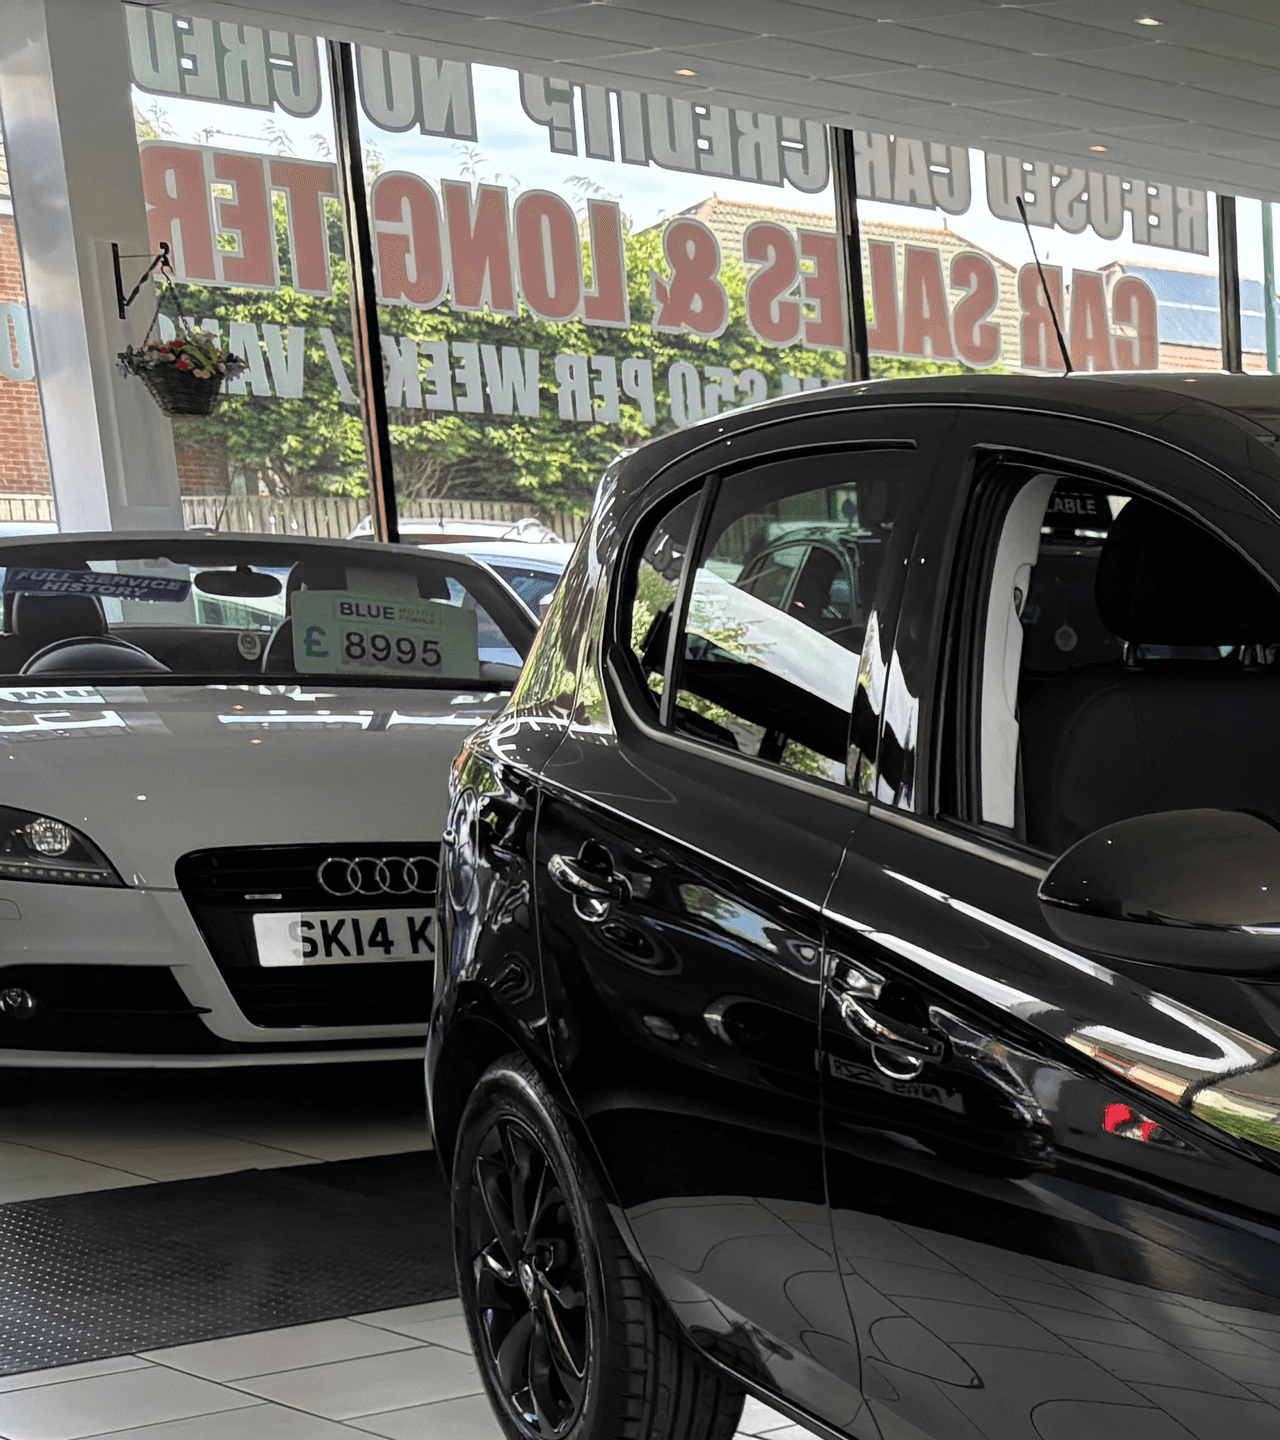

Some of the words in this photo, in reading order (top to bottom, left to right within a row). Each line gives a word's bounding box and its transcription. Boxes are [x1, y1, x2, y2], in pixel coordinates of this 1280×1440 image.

[16, 571, 75, 583] FULL
[82, 574, 182, 593] SERVICE
[42, 581, 149, 597] HISTORY
[340, 601, 395, 621] BLUE
[304, 626, 331, 658] £
[344, 632, 443, 668] 8995
[295, 917, 393, 959] SK14
[407, 915, 435, 956] K
